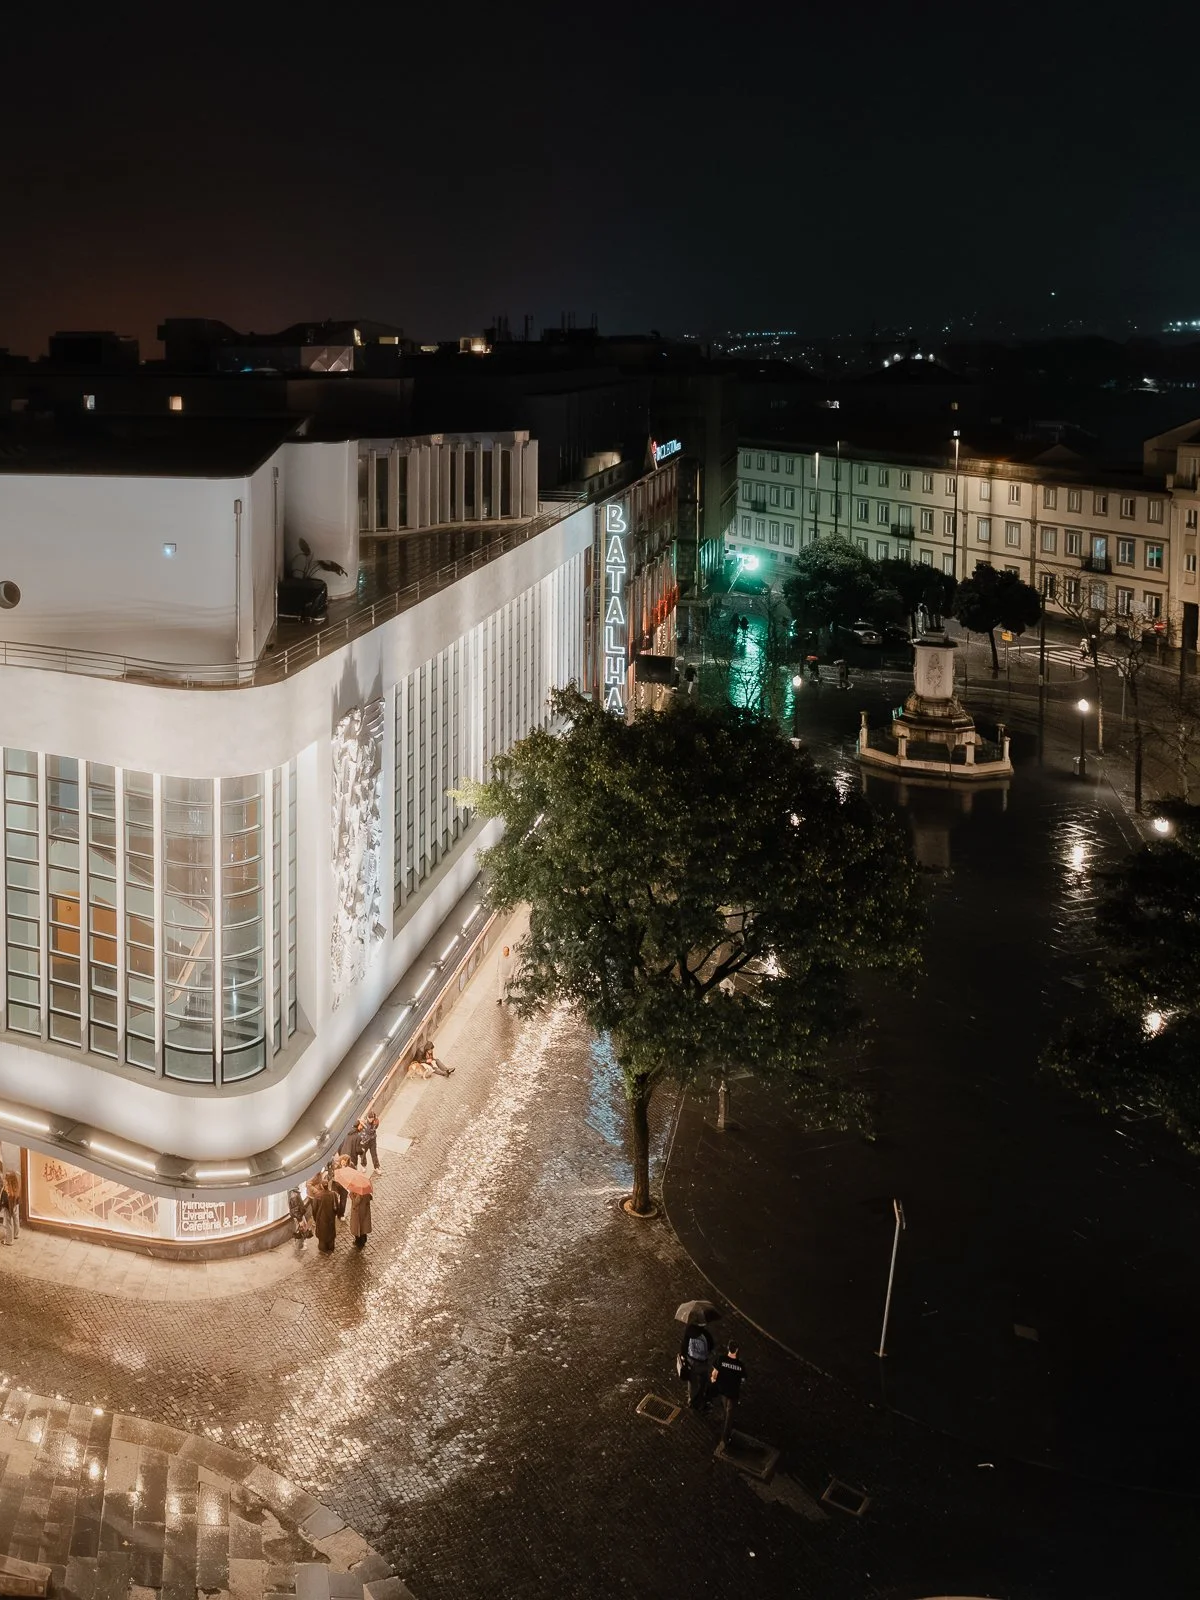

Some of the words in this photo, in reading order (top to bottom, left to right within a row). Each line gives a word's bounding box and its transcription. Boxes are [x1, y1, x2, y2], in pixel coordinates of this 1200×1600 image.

[605, 504, 627, 715] BATALHA
[181, 1210, 214, 1221] Livraria
[223, 1217, 231, 1227] &
[233, 1214, 248, 1226] Bar
